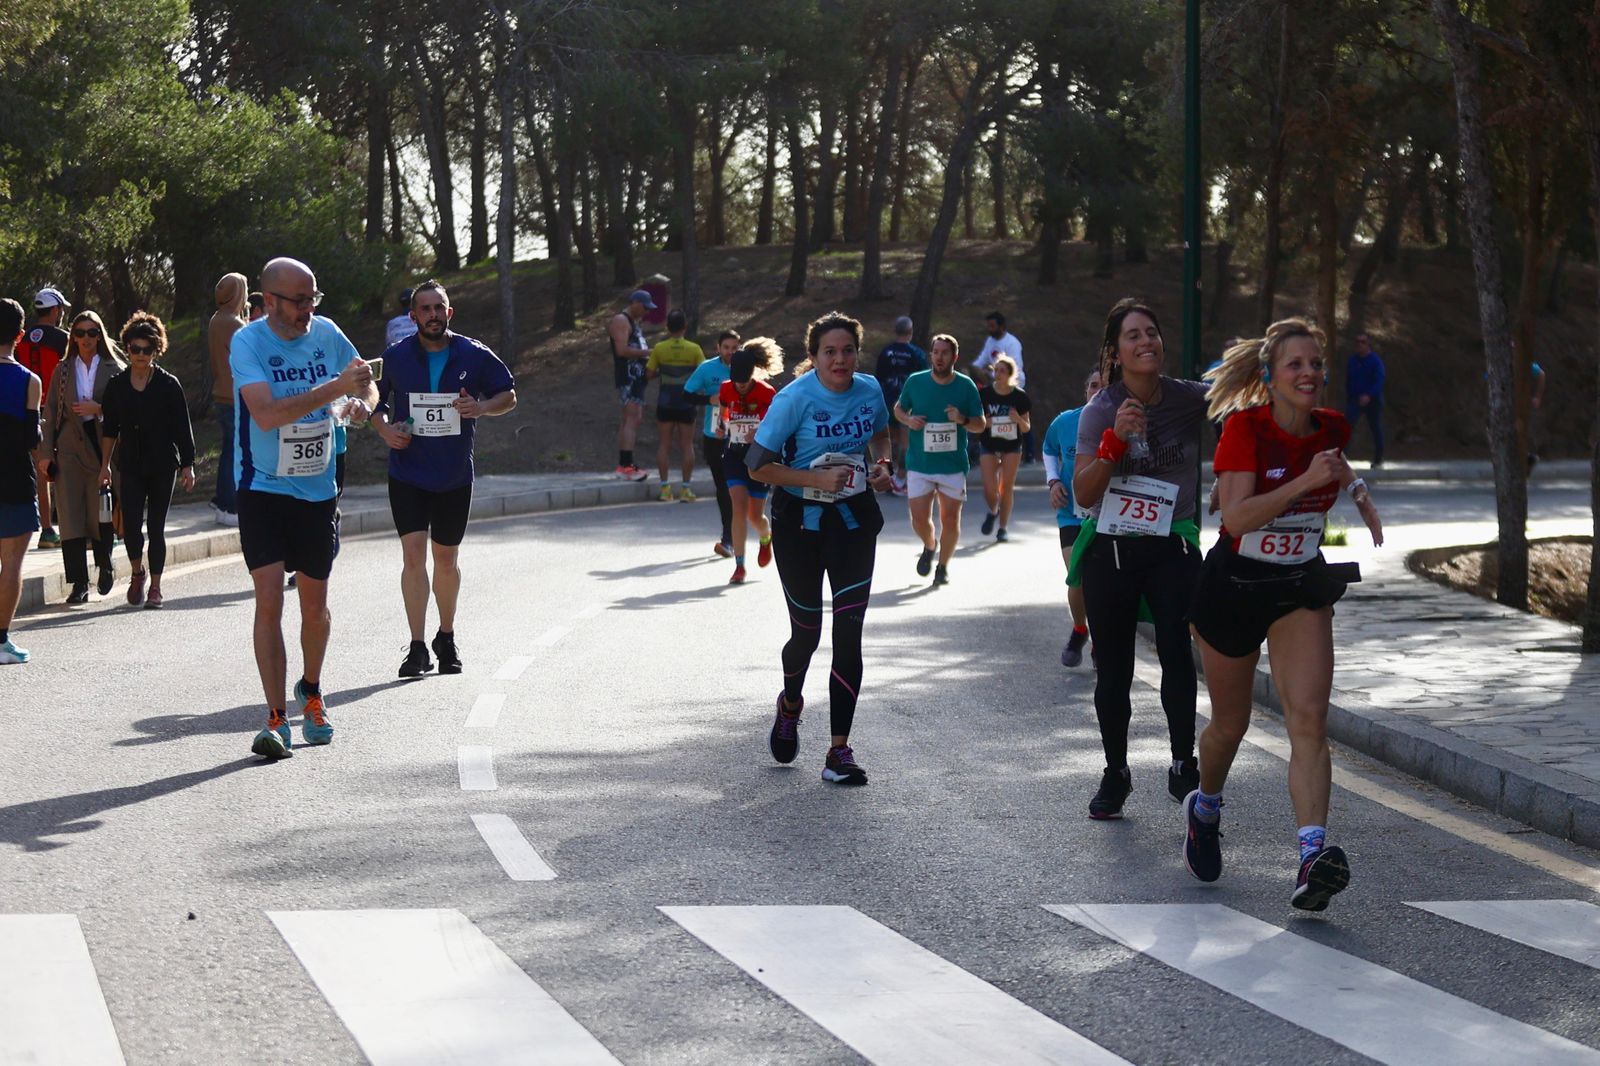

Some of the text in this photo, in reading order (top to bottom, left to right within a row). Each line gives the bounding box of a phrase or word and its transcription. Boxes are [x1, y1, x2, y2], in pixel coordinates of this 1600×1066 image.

[272, 361, 328, 384] nerja
[426, 408, 445, 422] 61
[816, 415, 872, 439] nerja
[931, 433, 951, 443] 136
[293, 441, 324, 460] 368
[1119, 497, 1159, 522] 735
[1260, 533, 1305, 556] 632
